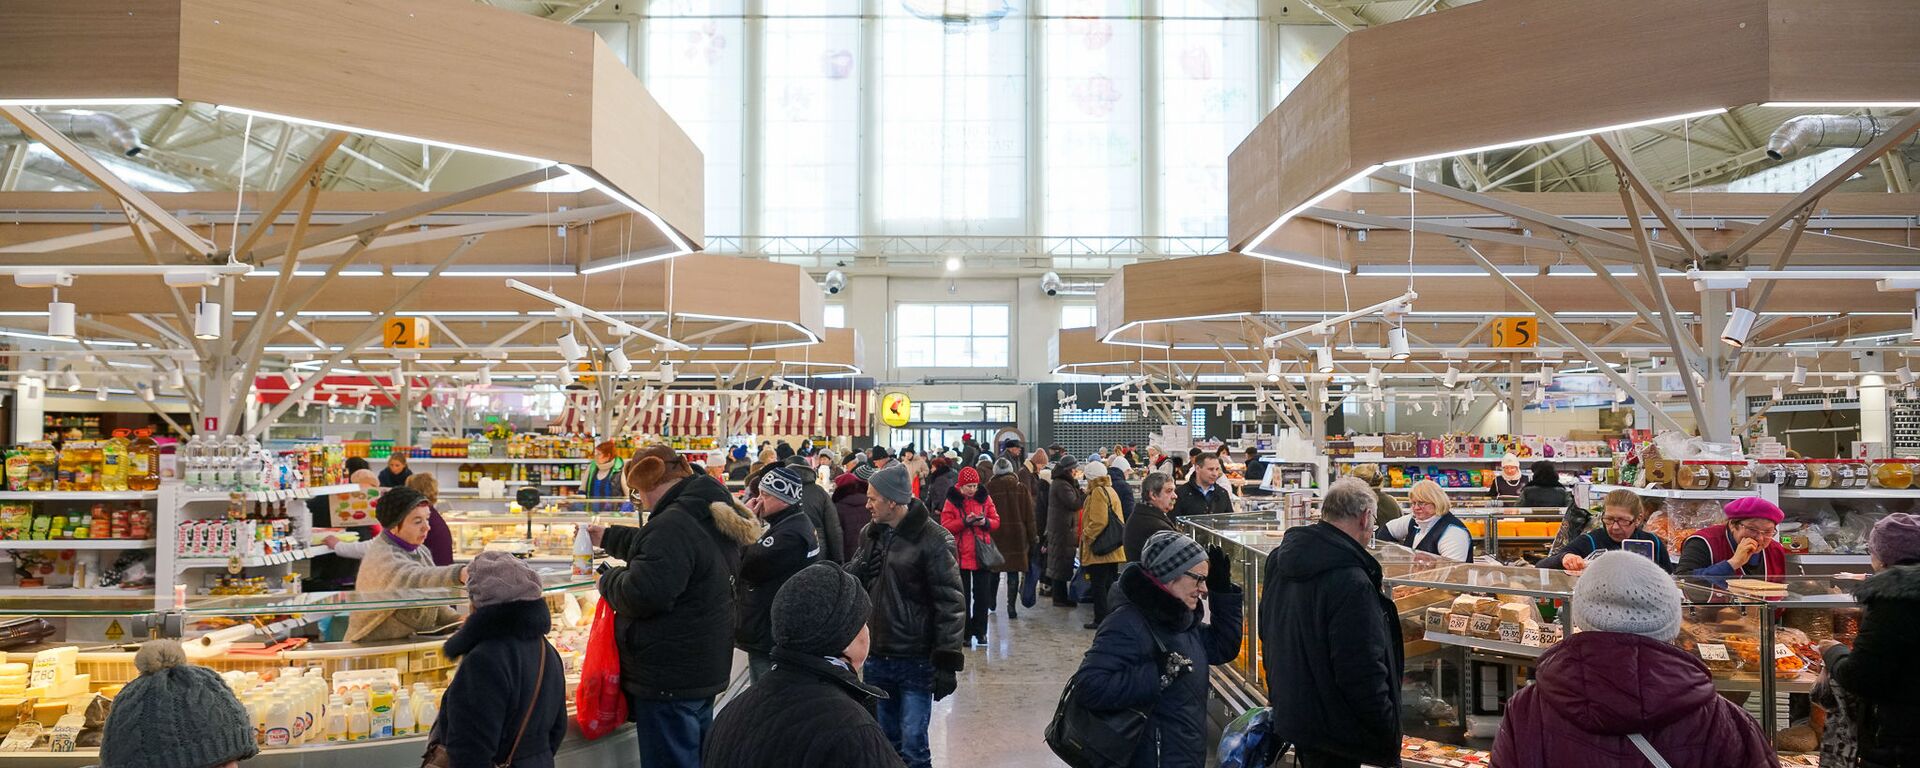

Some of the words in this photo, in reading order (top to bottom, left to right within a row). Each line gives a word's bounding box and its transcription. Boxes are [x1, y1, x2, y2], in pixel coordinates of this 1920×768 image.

[392, 321, 407, 345] 2
[1496, 321, 1503, 347] 5
[1515, 320, 1530, 346] 5
[1390, 440, 1413, 452] VIP
